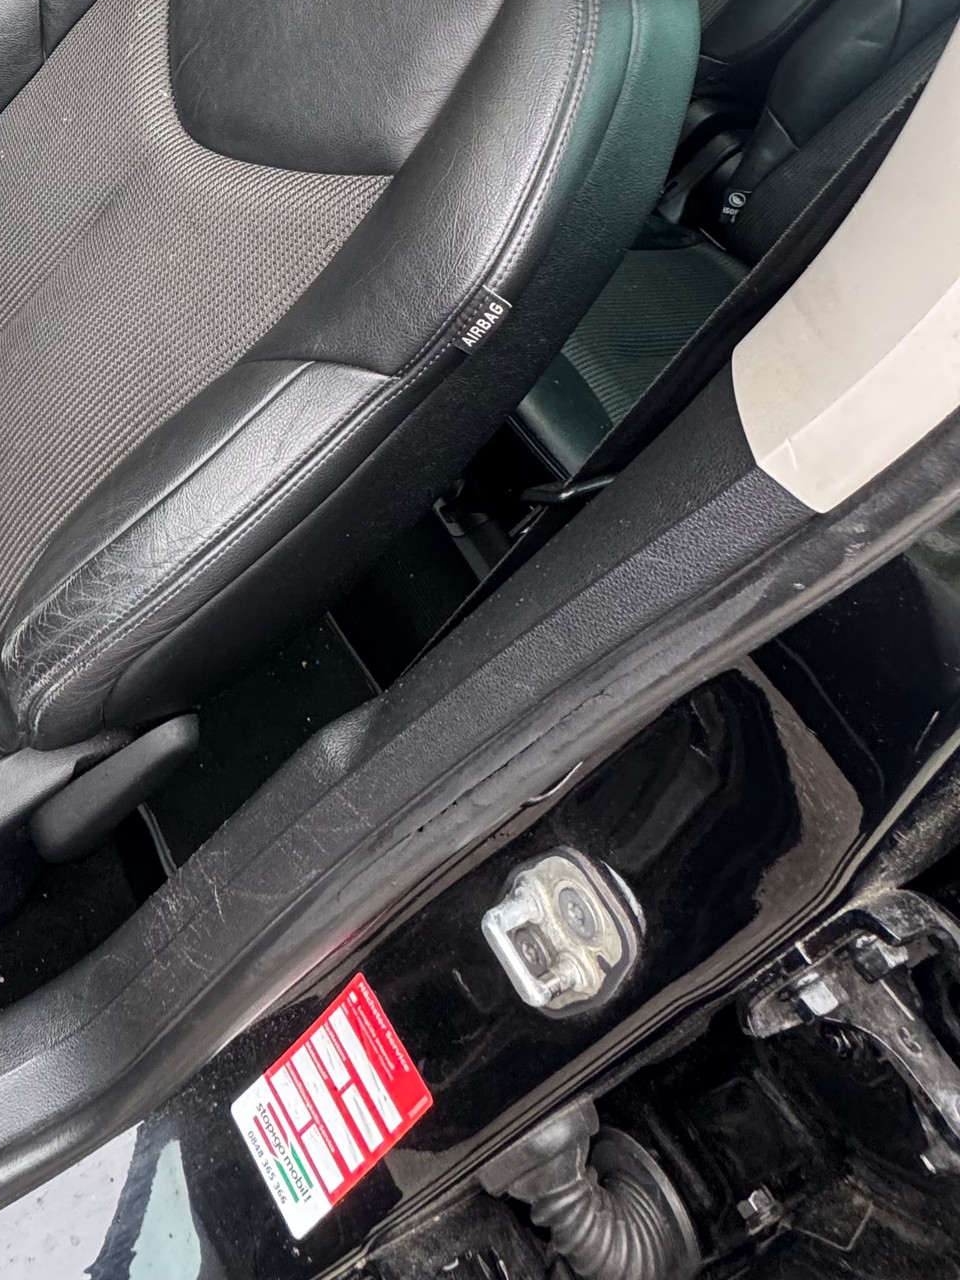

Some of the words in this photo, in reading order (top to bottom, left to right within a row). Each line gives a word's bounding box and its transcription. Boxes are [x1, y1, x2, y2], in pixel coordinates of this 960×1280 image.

[722, 206, 739, 216] ISOF
[461, 302, 504, 347] AIRBAG
[385, 1030, 410, 1072] Service
[247, 1130, 265, 1158] 0848
[262, 1158, 276, 1181] 365
[274, 1181, 288, 1204] 366
